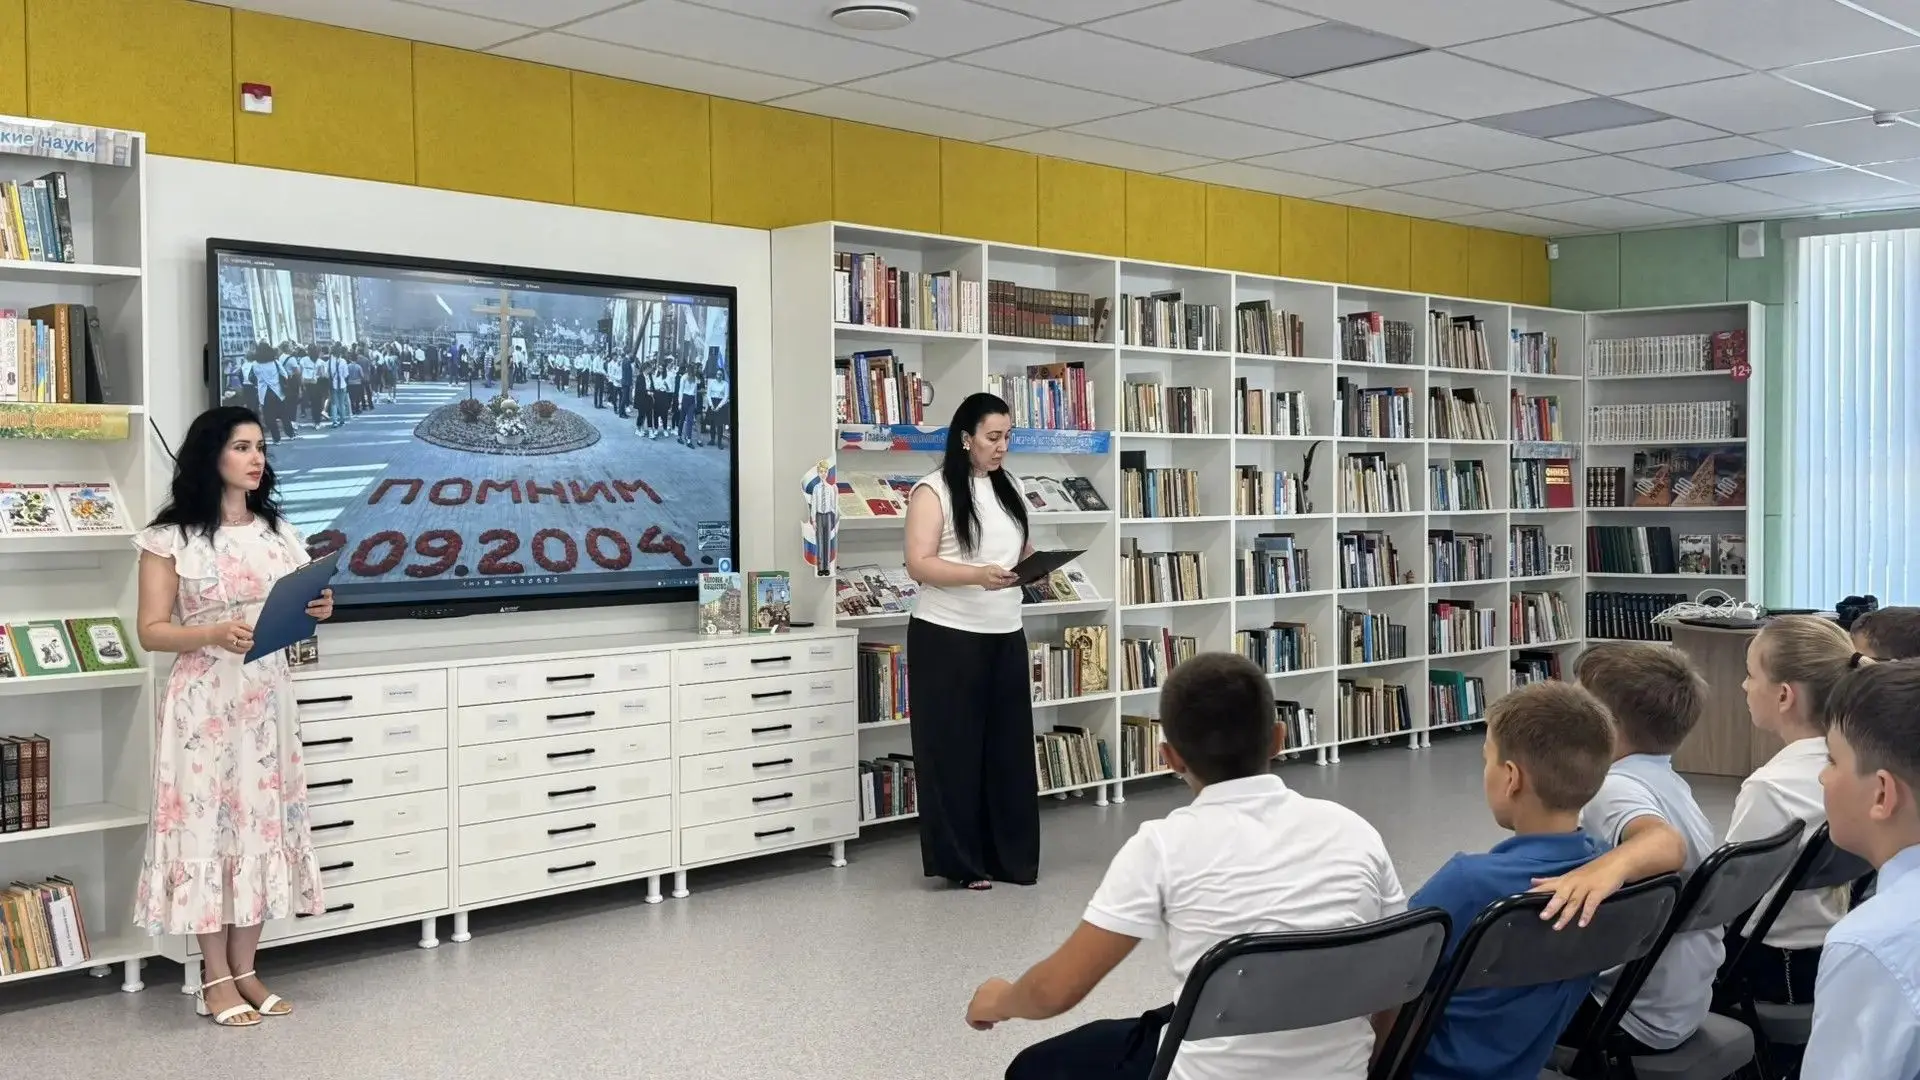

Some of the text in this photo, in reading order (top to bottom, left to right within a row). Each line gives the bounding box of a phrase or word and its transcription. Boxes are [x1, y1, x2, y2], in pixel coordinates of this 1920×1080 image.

[41, 136, 95, 153] науки
[1732, 365, 1752, 377] 12+
[367, 477, 663, 506] ПОМНИМ
